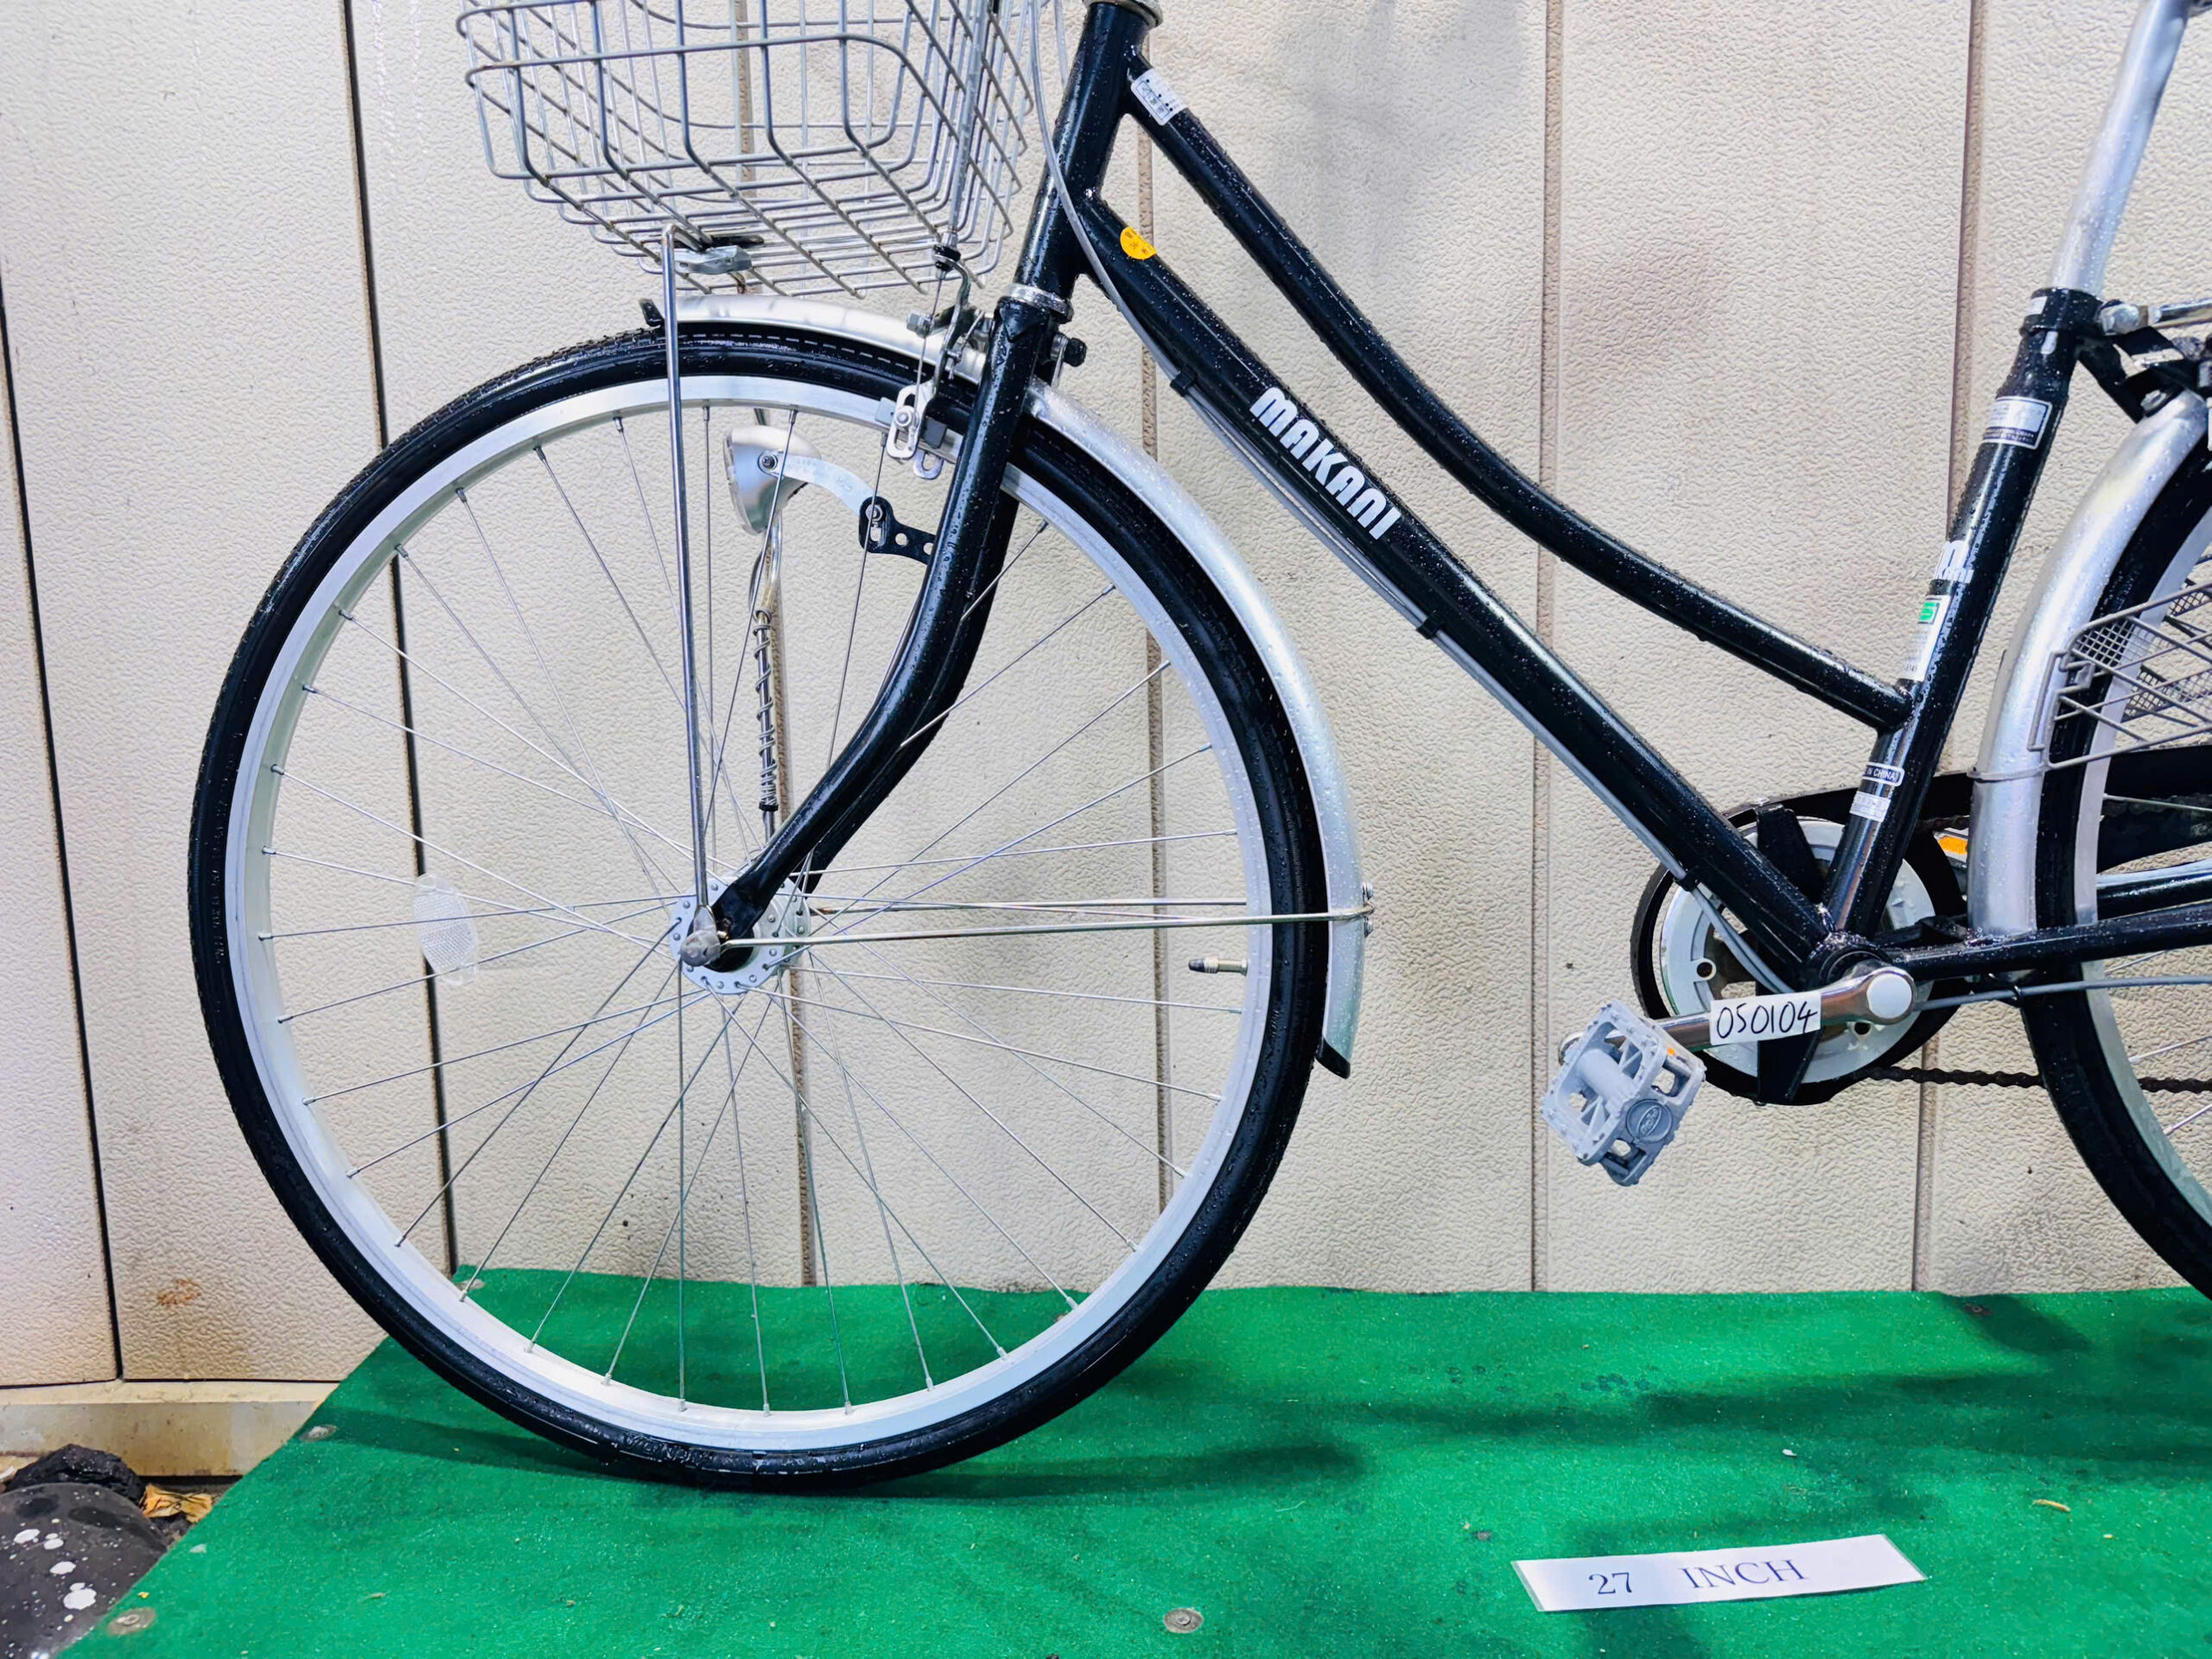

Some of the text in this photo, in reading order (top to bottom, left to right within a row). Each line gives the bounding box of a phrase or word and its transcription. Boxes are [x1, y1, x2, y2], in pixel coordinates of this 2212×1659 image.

[1249, 387, 1402, 540] MAKANI
[1872, 767, 1897, 782] CHINA
[1716, 1001, 1818, 1039] 050104
[1588, 1559, 1809, 1595] 27 INCH
